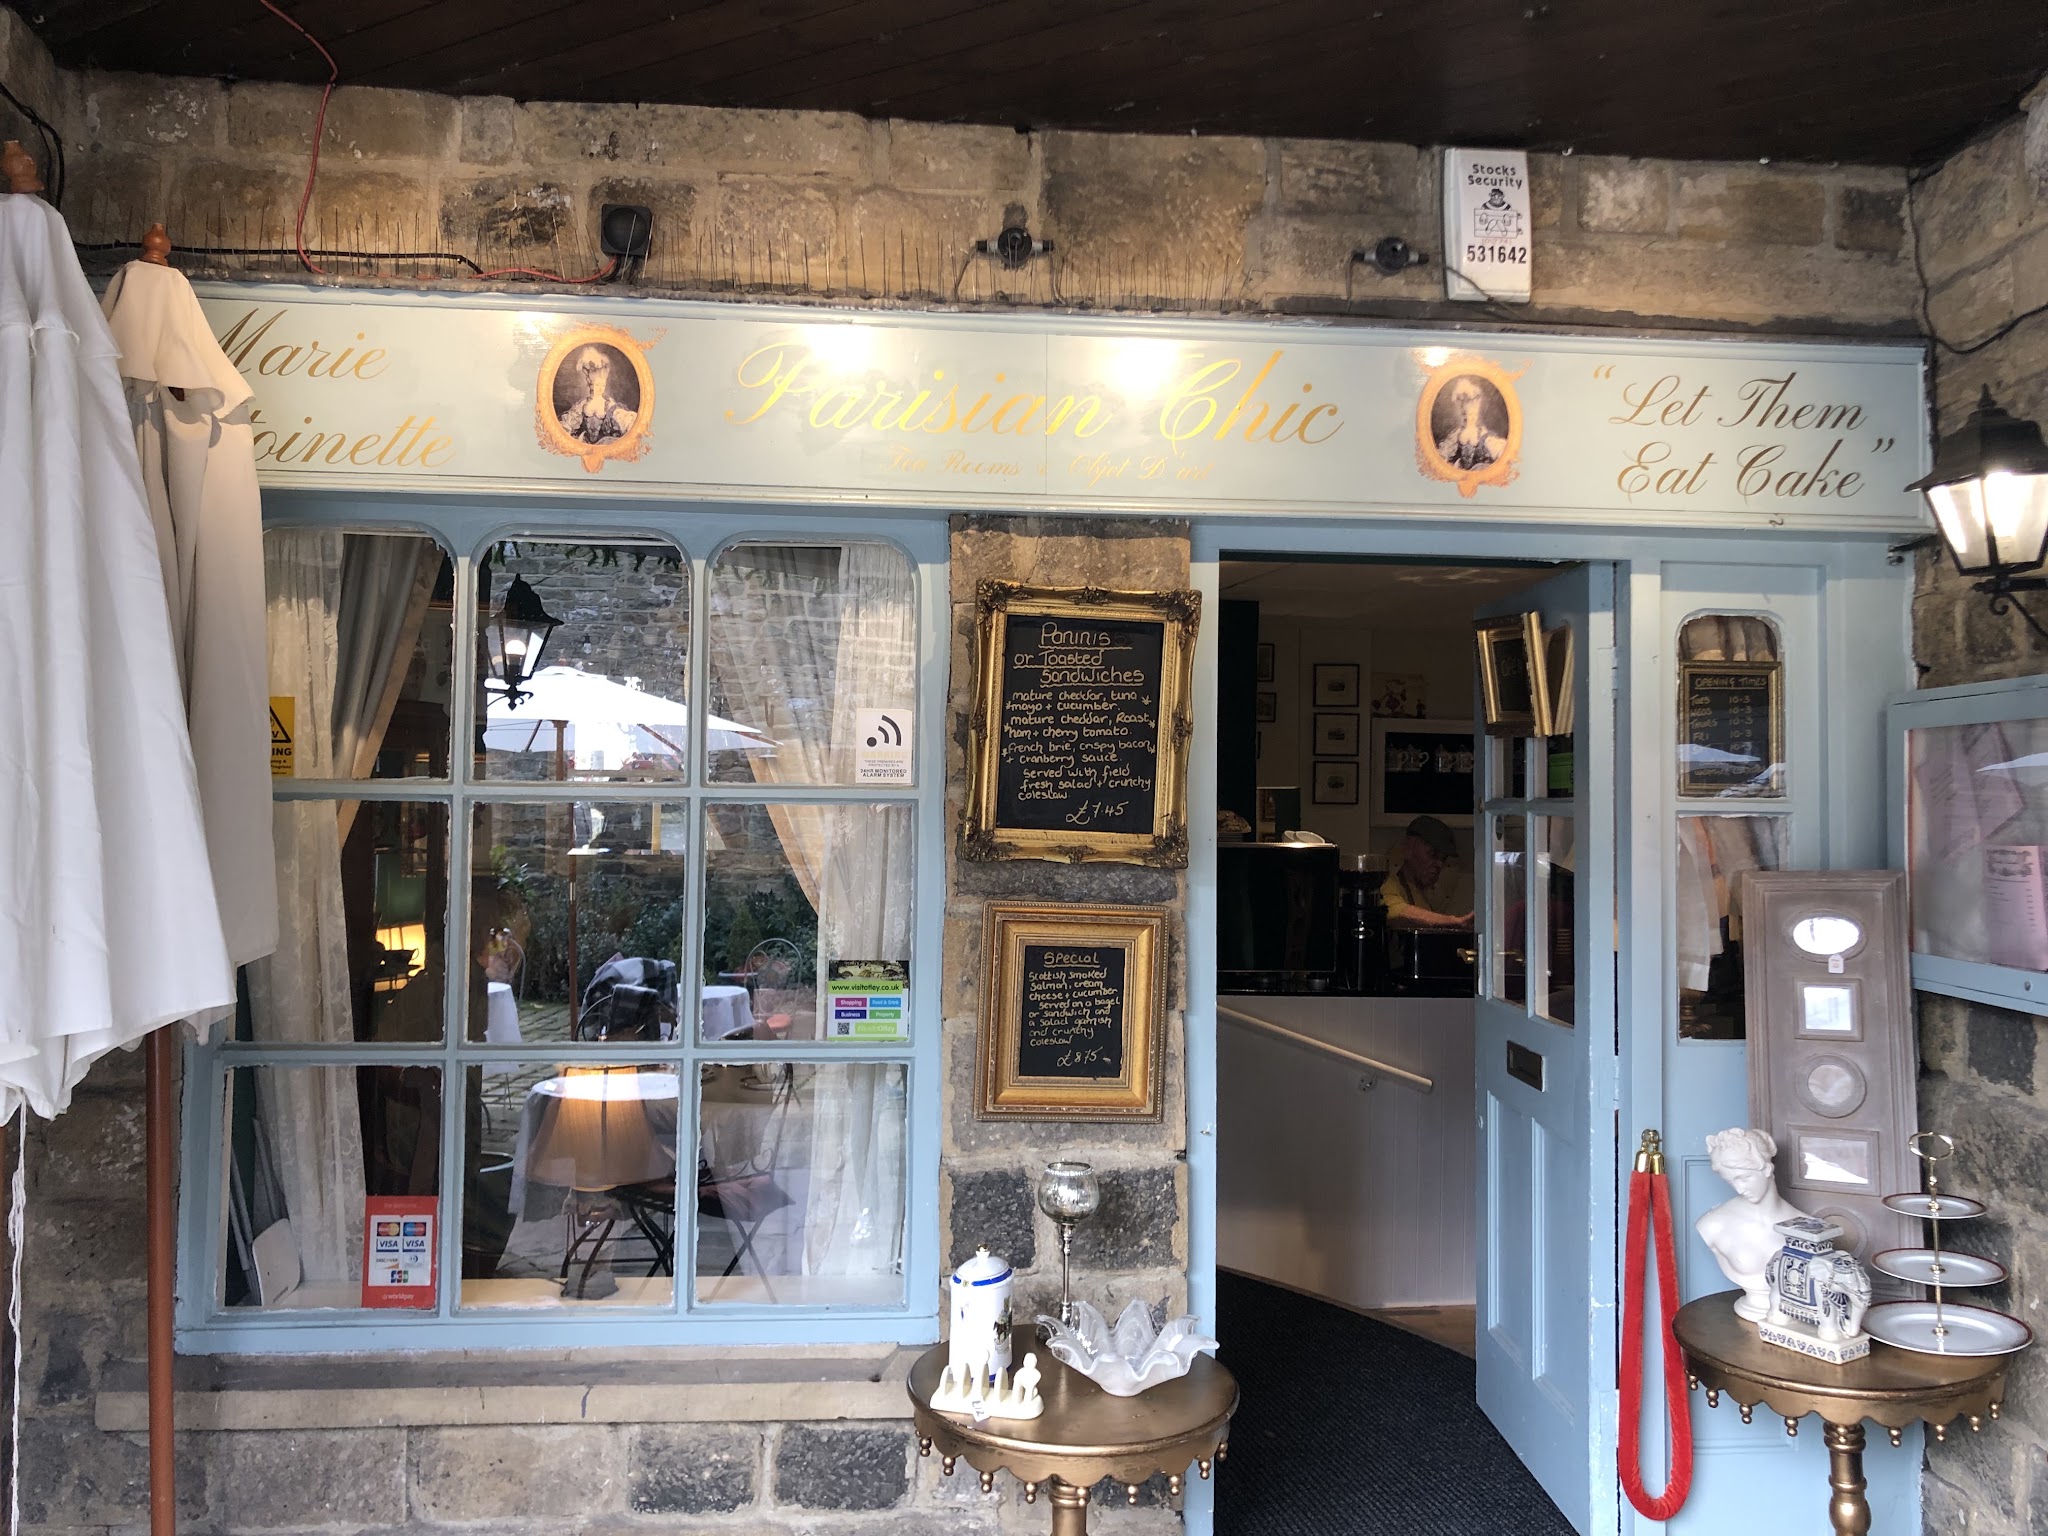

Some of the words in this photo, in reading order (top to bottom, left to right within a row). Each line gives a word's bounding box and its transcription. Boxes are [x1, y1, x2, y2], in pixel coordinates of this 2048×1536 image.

[1472, 164, 1516, 176] Stocks
[1468, 175, 1522, 190] Security
[1466, 245, 1527, 264] 531642
[216, 307, 391, 380] Marie
[725, 342, 1115, 438] Parisian
[1159, 349, 1345, 456] Chic
[1717, 372, 1869, 430] Them
[250, 409, 458, 468] toinette
[937, 450, 1022, 478] Rooms
[1617, 441, 1718, 504] Eat
[1041, 621, 1111, 646] Paninis
[1014, 653, 1035, 666] or
[1038, 649, 1105, 666] Toasted
[1695, 678, 1735, 688] OPENING
[1739, 677, 1767, 686] TIMES
[1012, 689, 1053, 702] mature
[1111, 690, 1137, 701] tuna
[1729, 695, 1751, 704] 10-3
[1011, 701, 1042, 715] mayo
[1729, 706, 1752, 714] 10-3
[1010, 711, 1055, 725] mature
[1008, 726, 1031, 740] ham
[1043, 726, 1079, 742] cherry
[1693, 732, 1710, 742] FRI
[1730, 729, 1753, 738] 10-3
[1079, 742, 1115, 757] crispy
[1118, 740, 1151, 753] bacon
[1068, 767, 1097, 782] with
[1102, 763, 1130, 783] field
[1020, 780, 1053, 793] fresh
[1058, 777, 1094, 789] salad
[1108, 776, 1151, 791] crunchy
[1028, 971, 1066, 983] Scottish
[831, 983, 900, 993] www.visitotley.co.uk
[1074, 980, 1104, 989] cream
[1095, 996, 1121, 1009] bagel
[1095, 1006, 1111, 1015] and
[1074, 1017, 1112, 1028] garnish
[1029, 1027, 1049, 1037] and
[1052, 1027, 1094, 1039] crunchy
[379, 1240, 398, 1248] VISA
[406, 1240, 425, 1248] VISA
